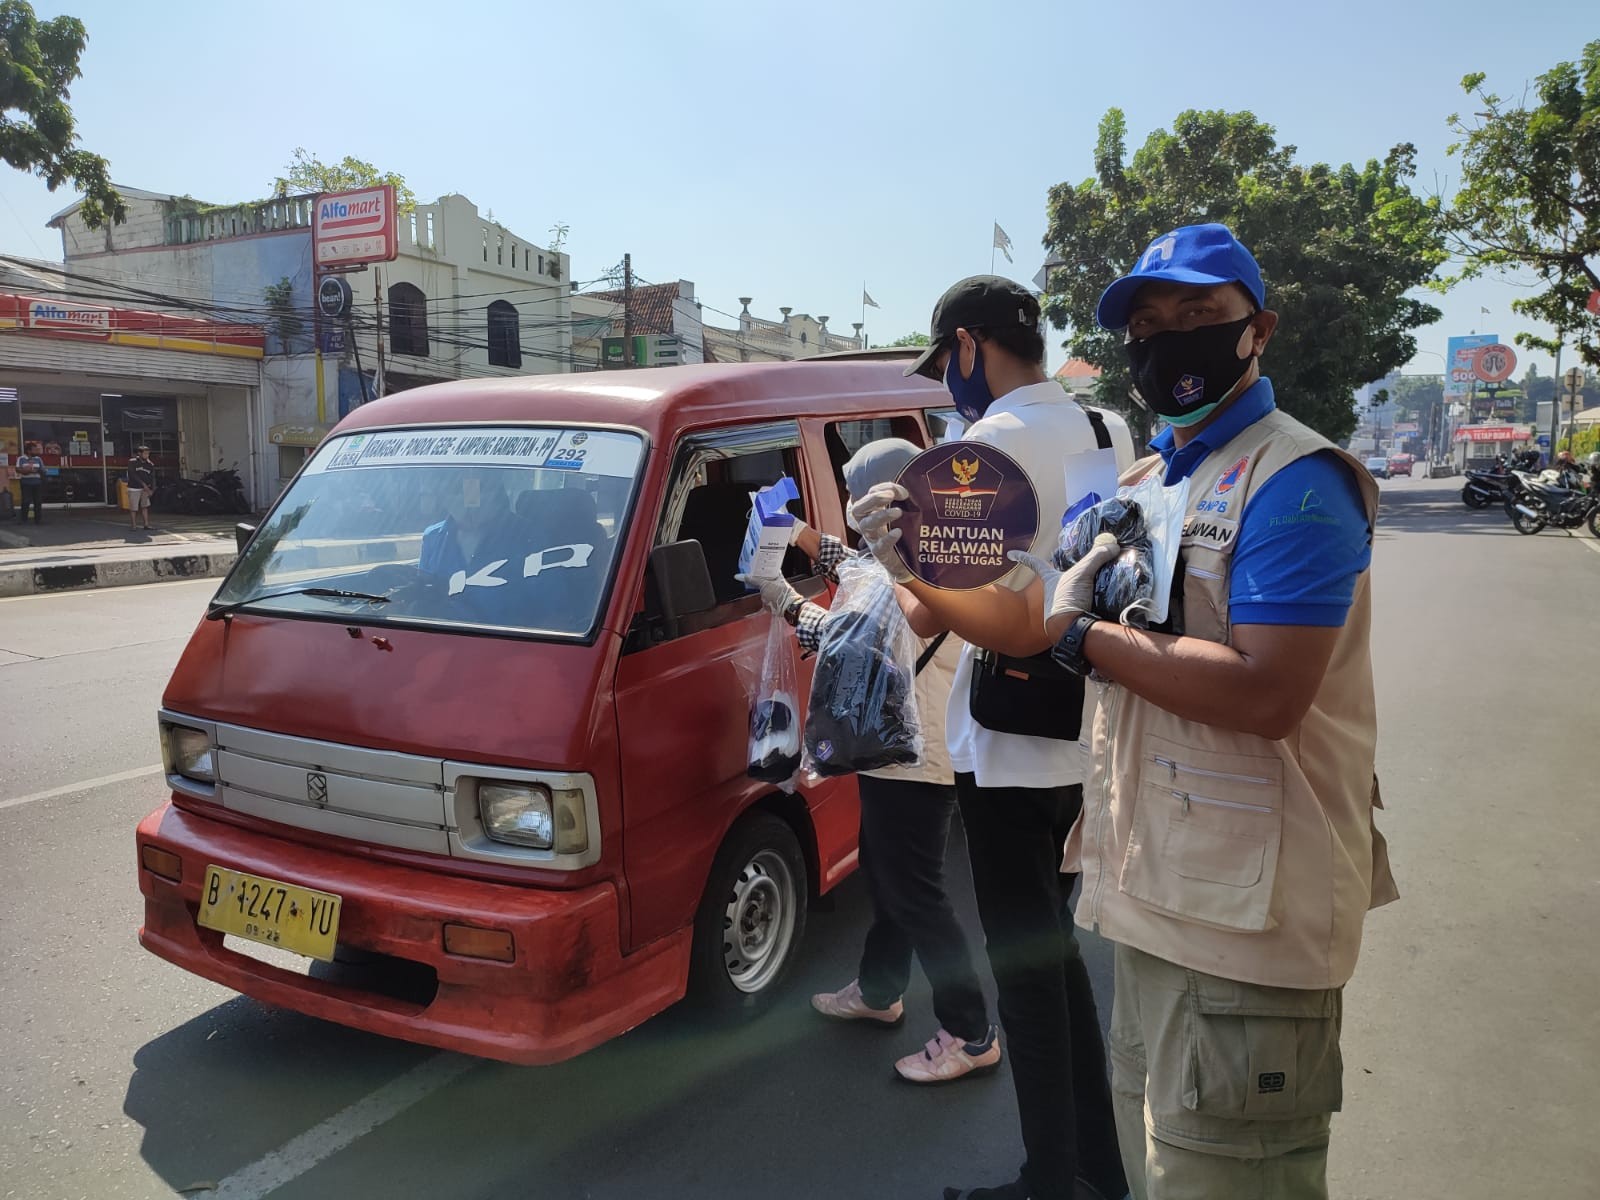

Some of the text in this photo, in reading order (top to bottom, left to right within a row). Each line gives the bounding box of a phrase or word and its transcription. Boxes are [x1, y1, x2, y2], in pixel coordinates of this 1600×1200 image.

[321, 197, 381, 220] Alfamart
[34, 304, 104, 325] Alfamart
[455, 437, 497, 455] KAMPUNG
[489, 436, 539, 456] RAMBUTAN
[553, 448, 587, 461] 292
[944, 510, 981, 518] COVID-19
[1196, 500, 1229, 513] BNPB
[920, 525, 1004, 540] BANTUAN
[919, 540, 1003, 555] RELAWAN
[918, 554, 1003, 566] GUGUS TUGAS
[208, 873, 335, 936] B 1247 YU
